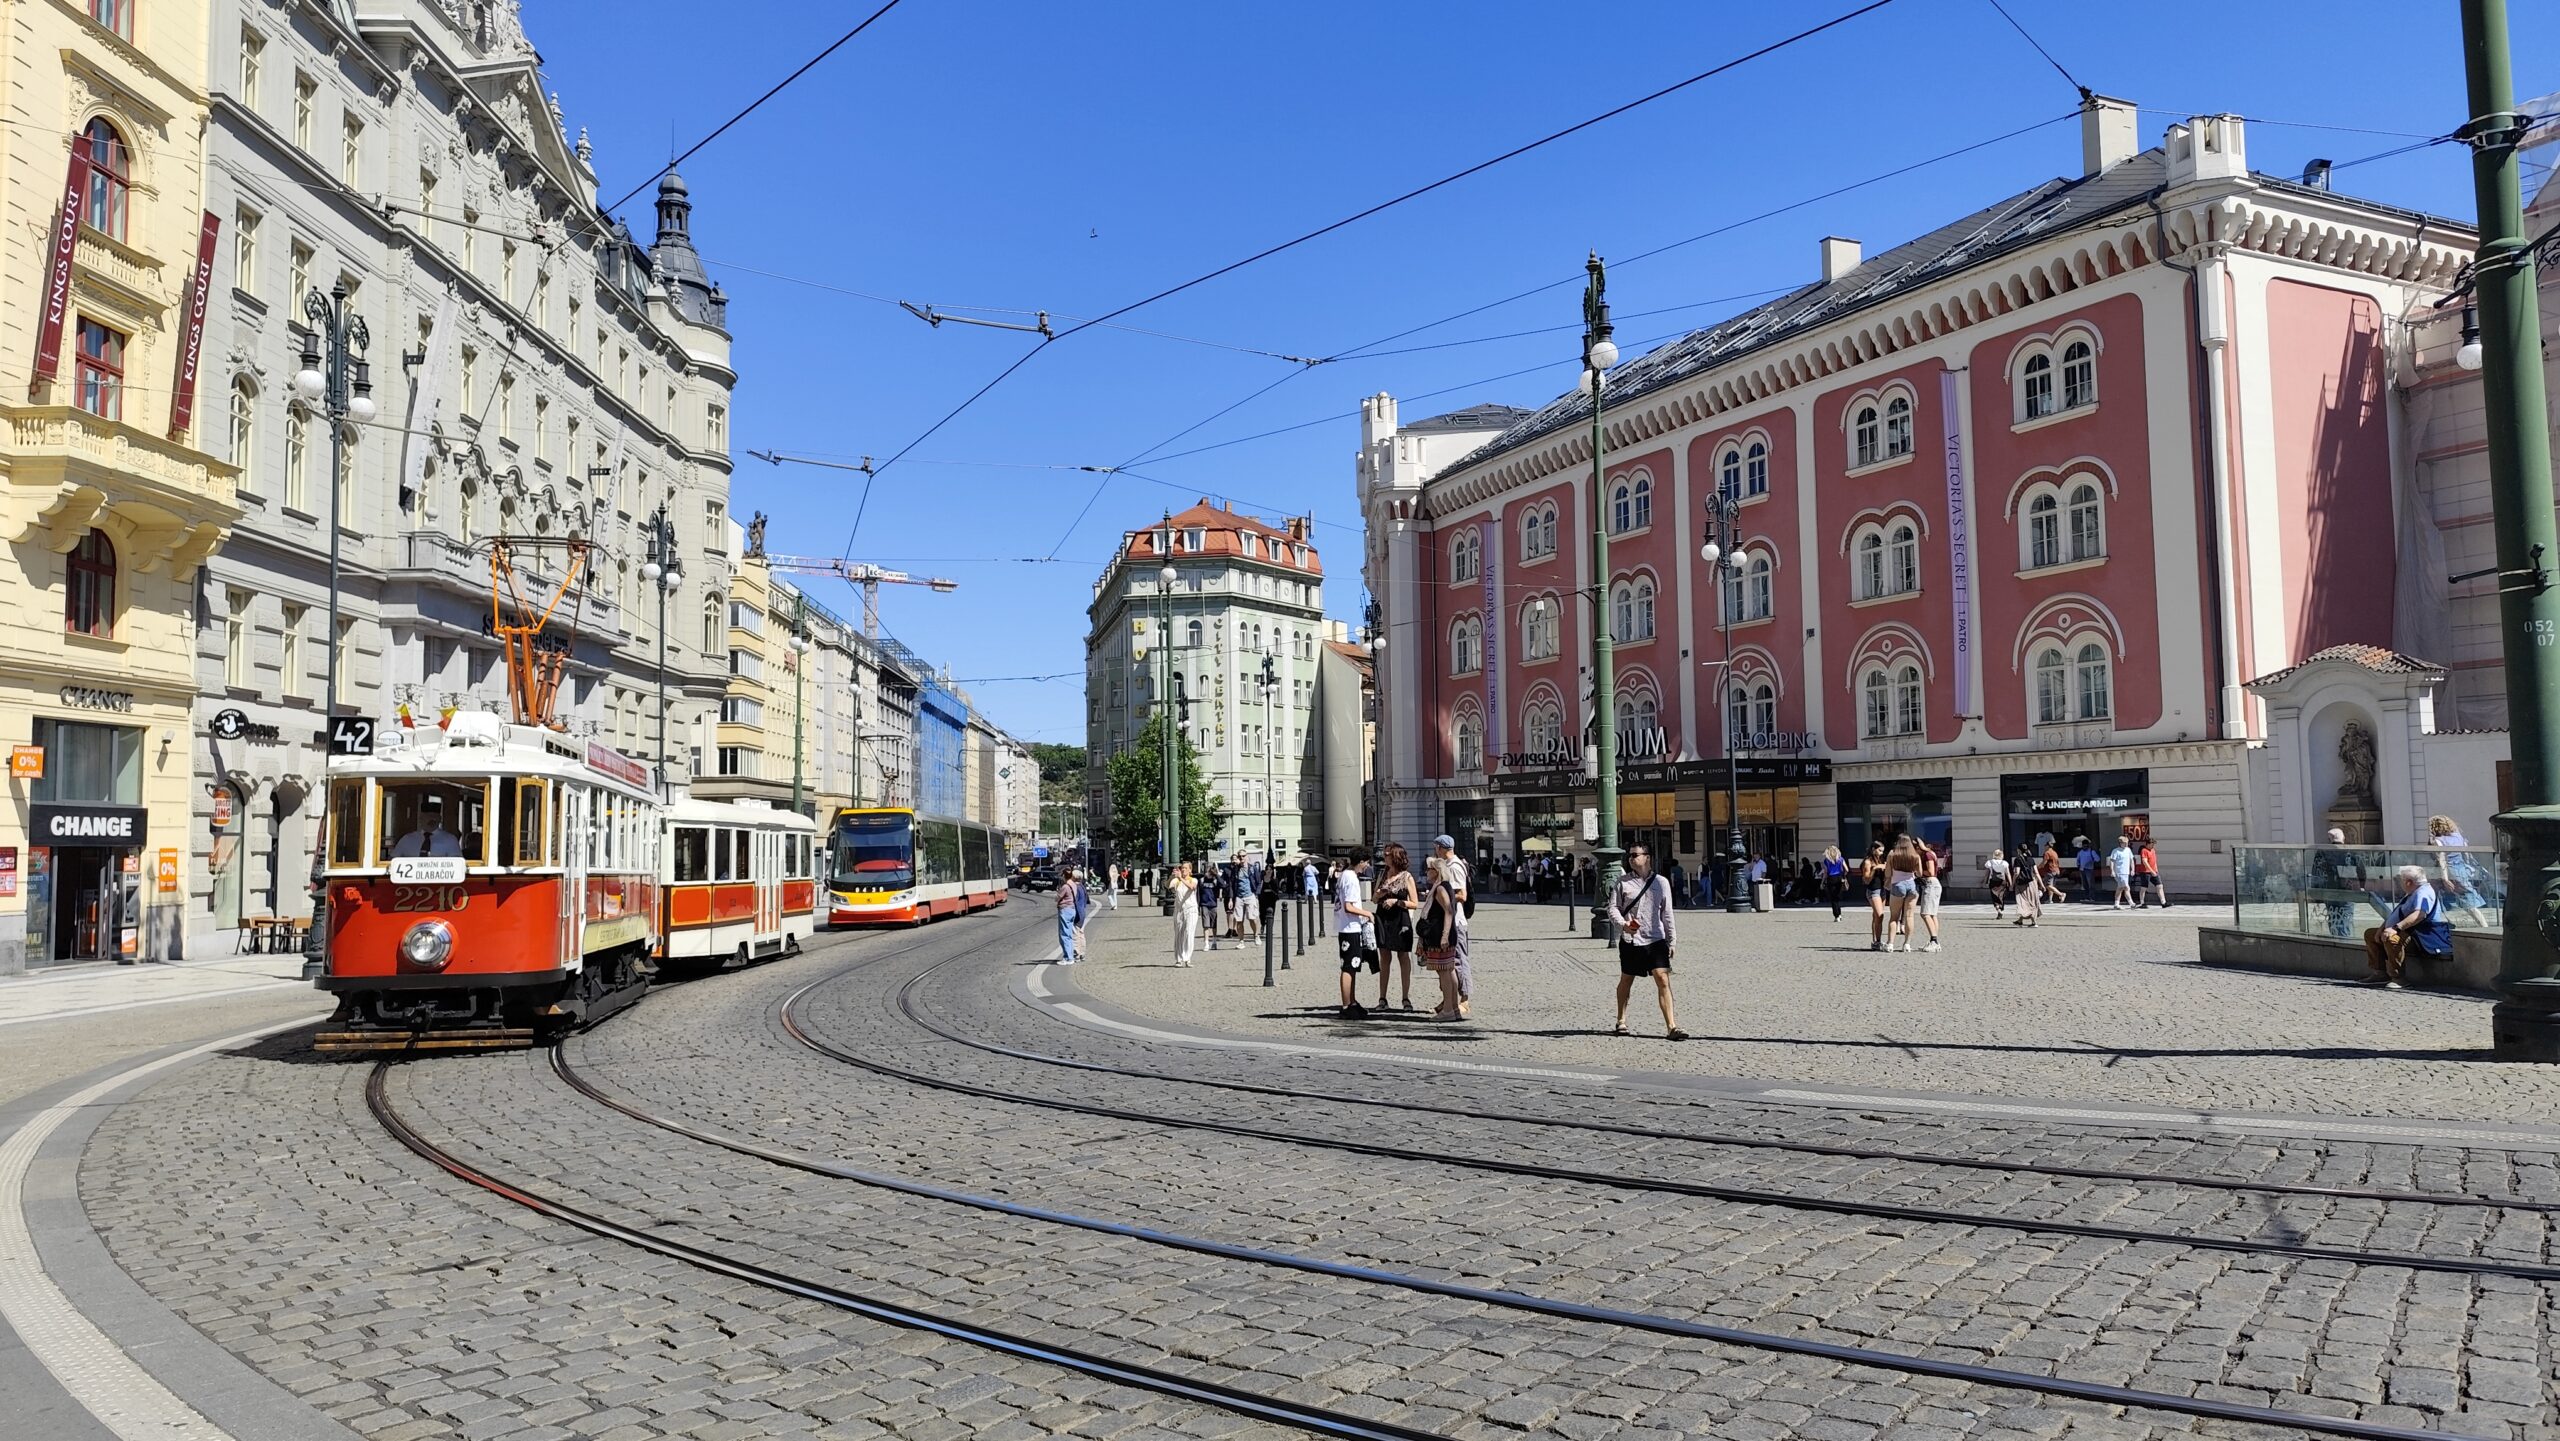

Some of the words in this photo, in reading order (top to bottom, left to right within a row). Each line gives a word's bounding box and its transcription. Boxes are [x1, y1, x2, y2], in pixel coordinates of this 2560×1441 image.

[49, 257, 68, 325] KINGS
[60, 186, 81, 254] COURT
[184, 320, 200, 383] KINGS
[194, 257, 211, 319] COURT
[1948, 433, 1964, 526] VICTORIA'S
[1953, 532, 1967, 594] SECRET
[1958, 619, 1967, 653] PATRO
[2523, 620, 2554, 633] 052
[2537, 633, 2555, 647] 07
[1488, 633, 1497, 673] SECRET
[1131, 617, 1150, 719] HOTE
[60, 685, 134, 713] CHANGE
[334, 721, 371, 753] 42
[1733, 731, 1817, 750] SHOPPING
[19, 755, 37, 767] 0%
[1783, 763, 1798, 777] GAP
[1567, 772, 1586, 787] 200
[2047, 801, 2081, 809] UNDER
[2082, 799, 2128, 808] ARMOUR
[50, 815, 133, 837] CHANGE
[161, 862, 175, 876] 0%
[396, 863, 413, 878] 42
[393, 886, 469, 912] 2210
